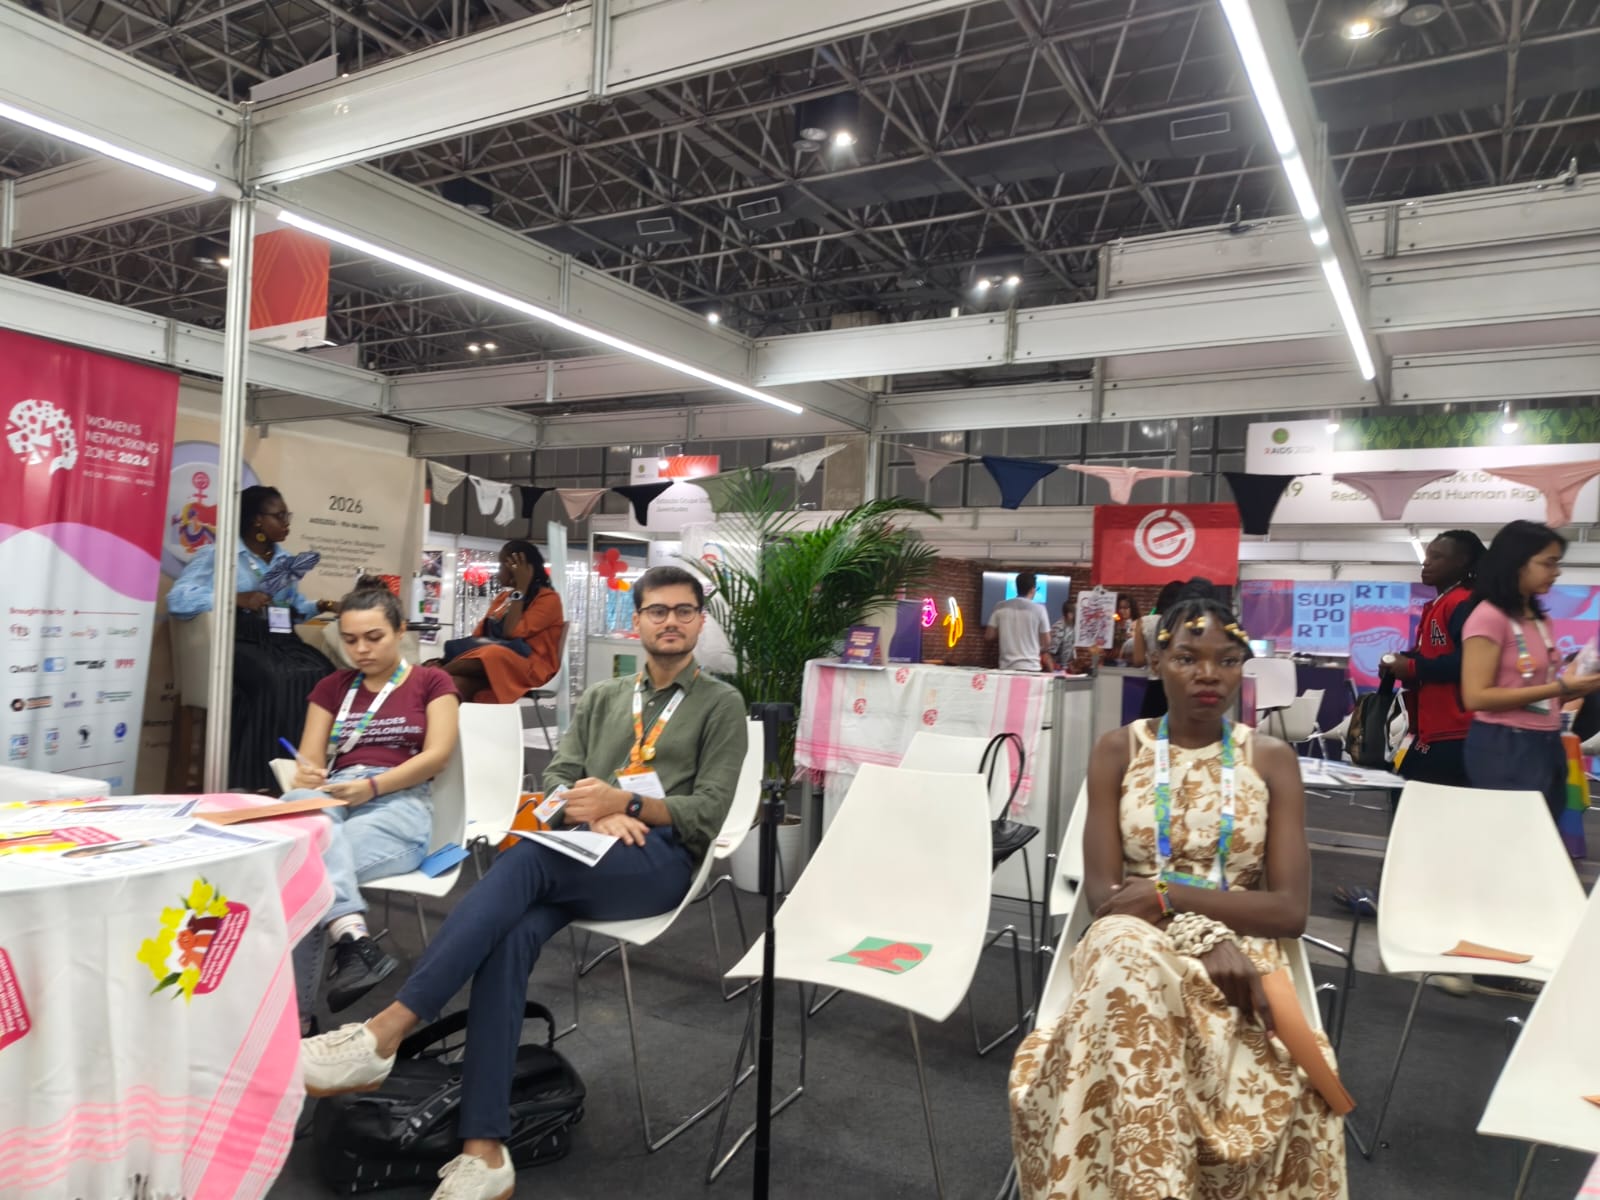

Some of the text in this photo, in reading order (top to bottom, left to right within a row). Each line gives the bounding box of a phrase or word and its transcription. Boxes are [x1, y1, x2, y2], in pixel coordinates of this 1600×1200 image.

[85, 414, 142, 436] WOMEN'S
[84, 431, 160, 455] NETWORKING
[84, 445, 150, 467] ZONE 2026
[1446, 488, 1505, 500] Human
[328, 495, 363, 514] 2026
[1297, 593, 1345, 608] SUP
[1313, 609, 1345, 623] PO
[1297, 624, 1329, 638] RT
